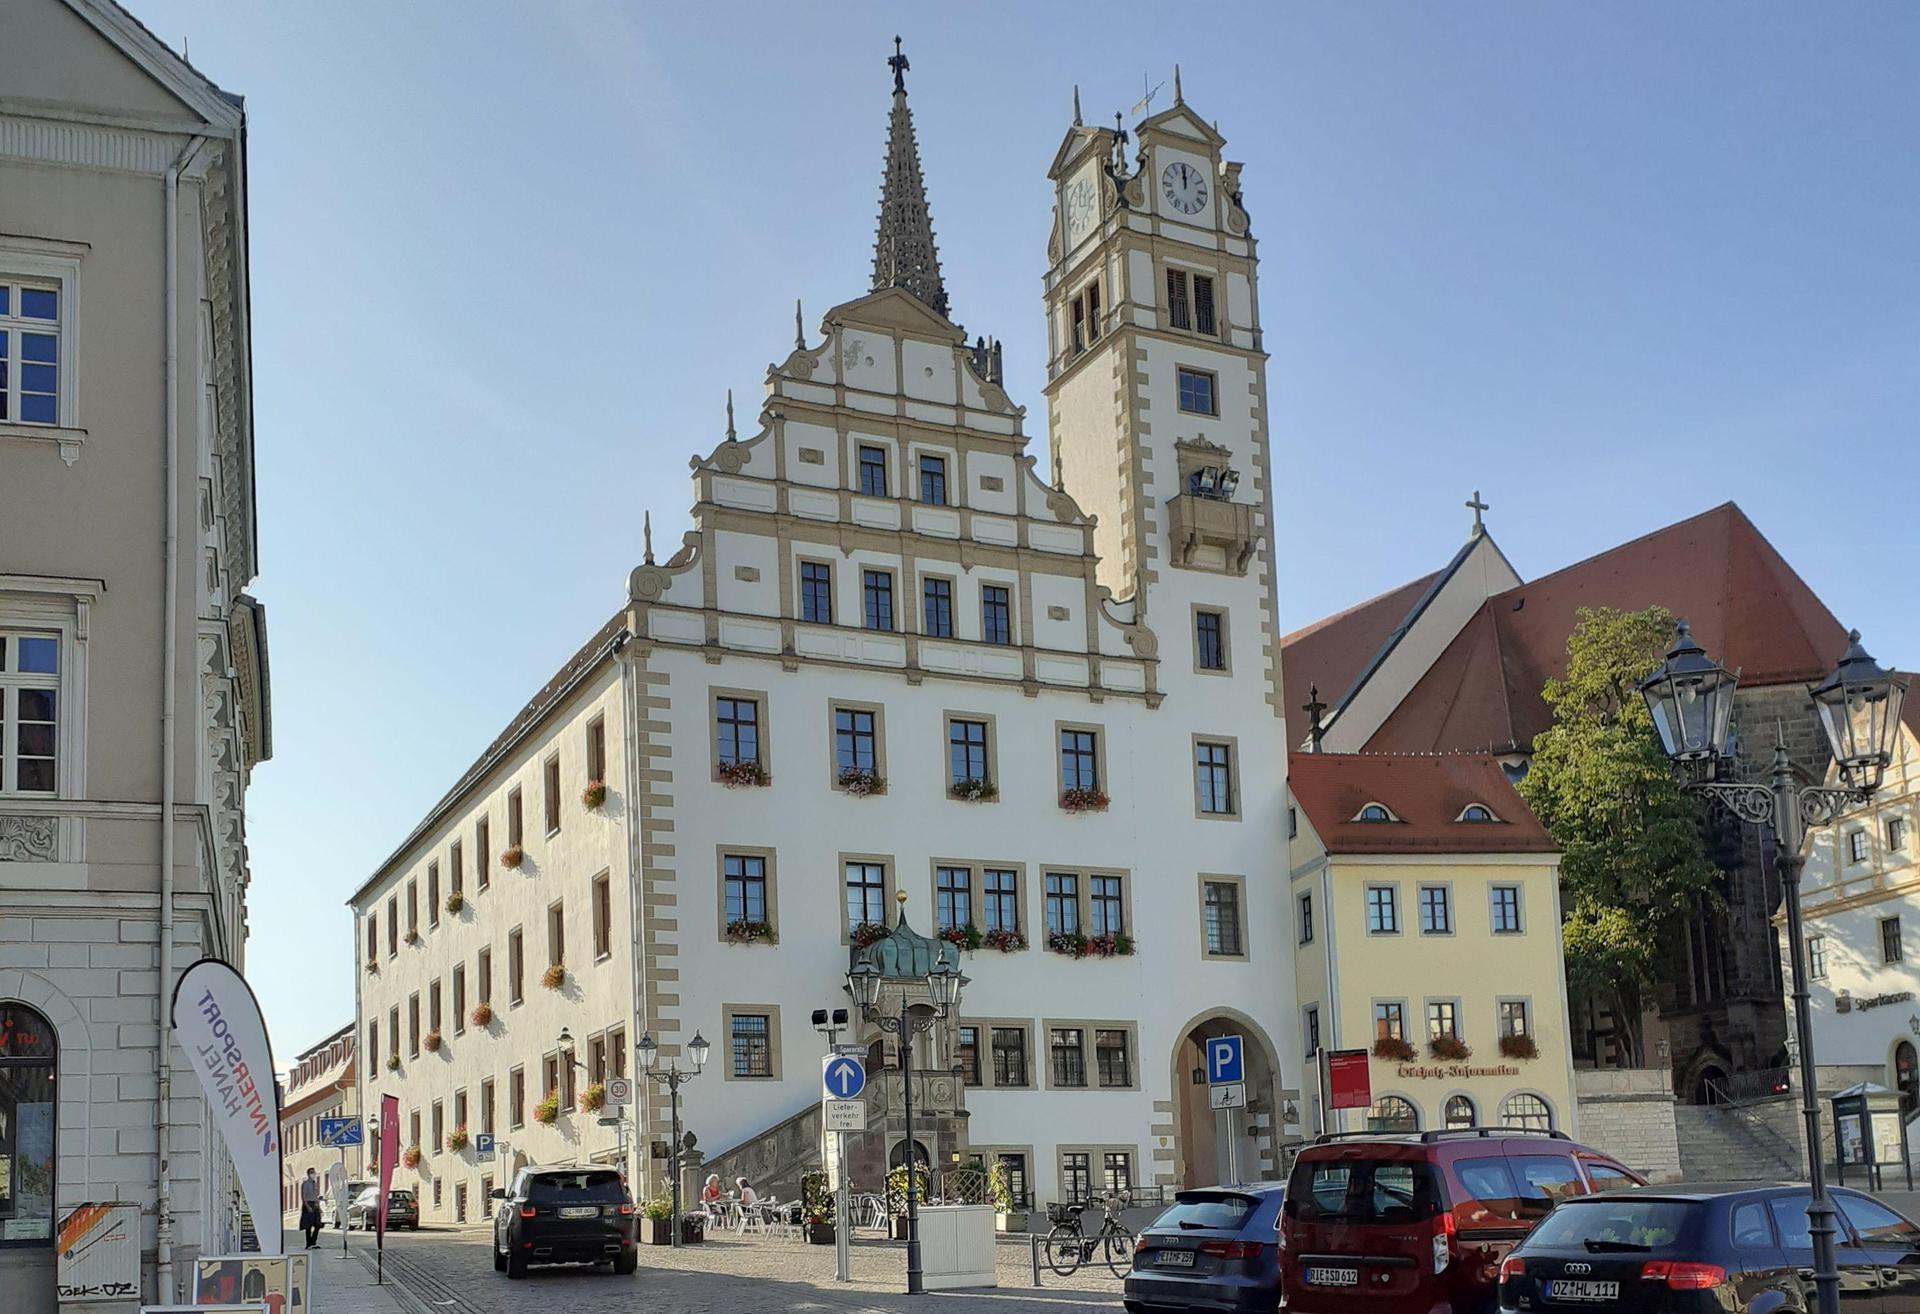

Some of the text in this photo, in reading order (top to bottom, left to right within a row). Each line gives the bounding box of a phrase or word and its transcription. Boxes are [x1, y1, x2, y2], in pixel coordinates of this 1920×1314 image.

[1215, 1043, 1234, 1078] P
[614, 1085, 625, 1094] 30
[831, 1112, 860, 1120] verkehr
[839, 1120, 853, 1128] frei
[479, 1136, 491, 1150] P
[1310, 1269, 1357, 1282] RIE SD 612
[1553, 1282, 1617, 1298] OZ HL 111
